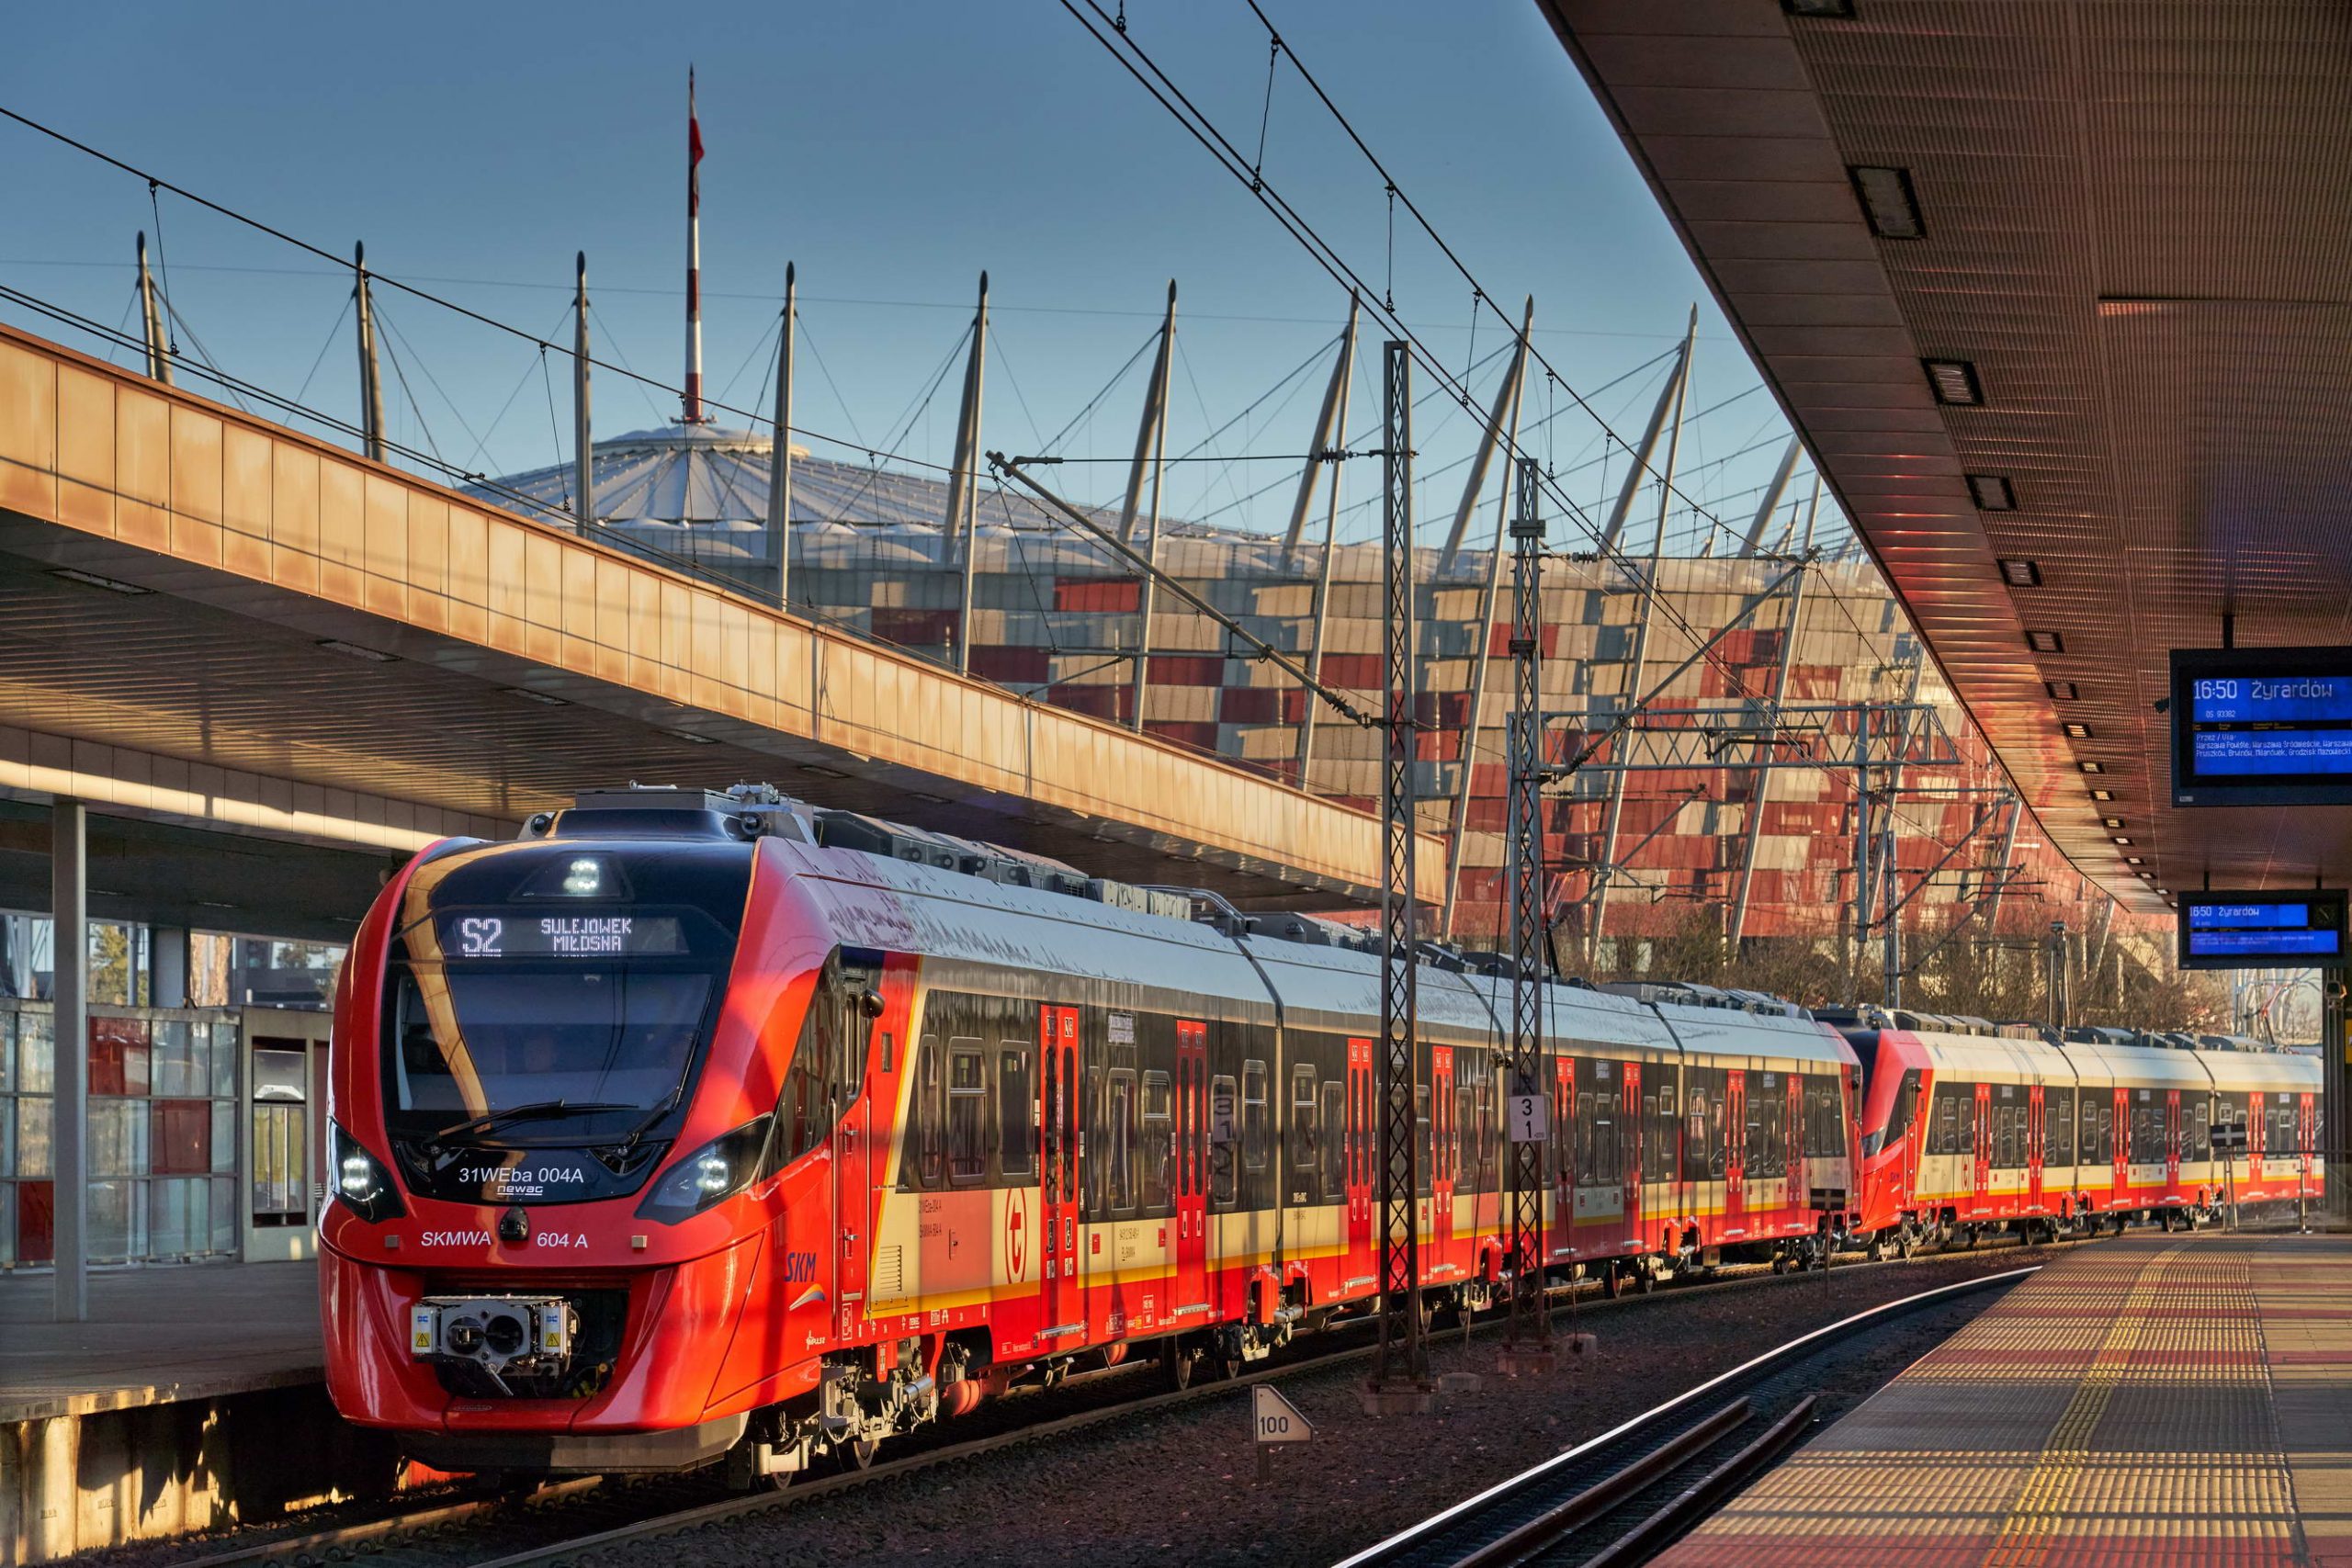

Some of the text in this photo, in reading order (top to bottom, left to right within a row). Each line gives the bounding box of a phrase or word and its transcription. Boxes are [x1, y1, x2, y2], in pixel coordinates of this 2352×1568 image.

[2193, 679, 2333, 700] 16:50 Żyrardów
[462, 919, 502, 952] S2
[1521, 1098, 1532, 1116] 3
[1525, 1120, 1532, 1139] 1
[459, 1168, 584, 1183] 31WEba 004A
[421, 1231, 589, 1248] SKMWA 604 A
[784, 1252, 817, 1283] SKM
[1260, 1416, 1289, 1436] 100
